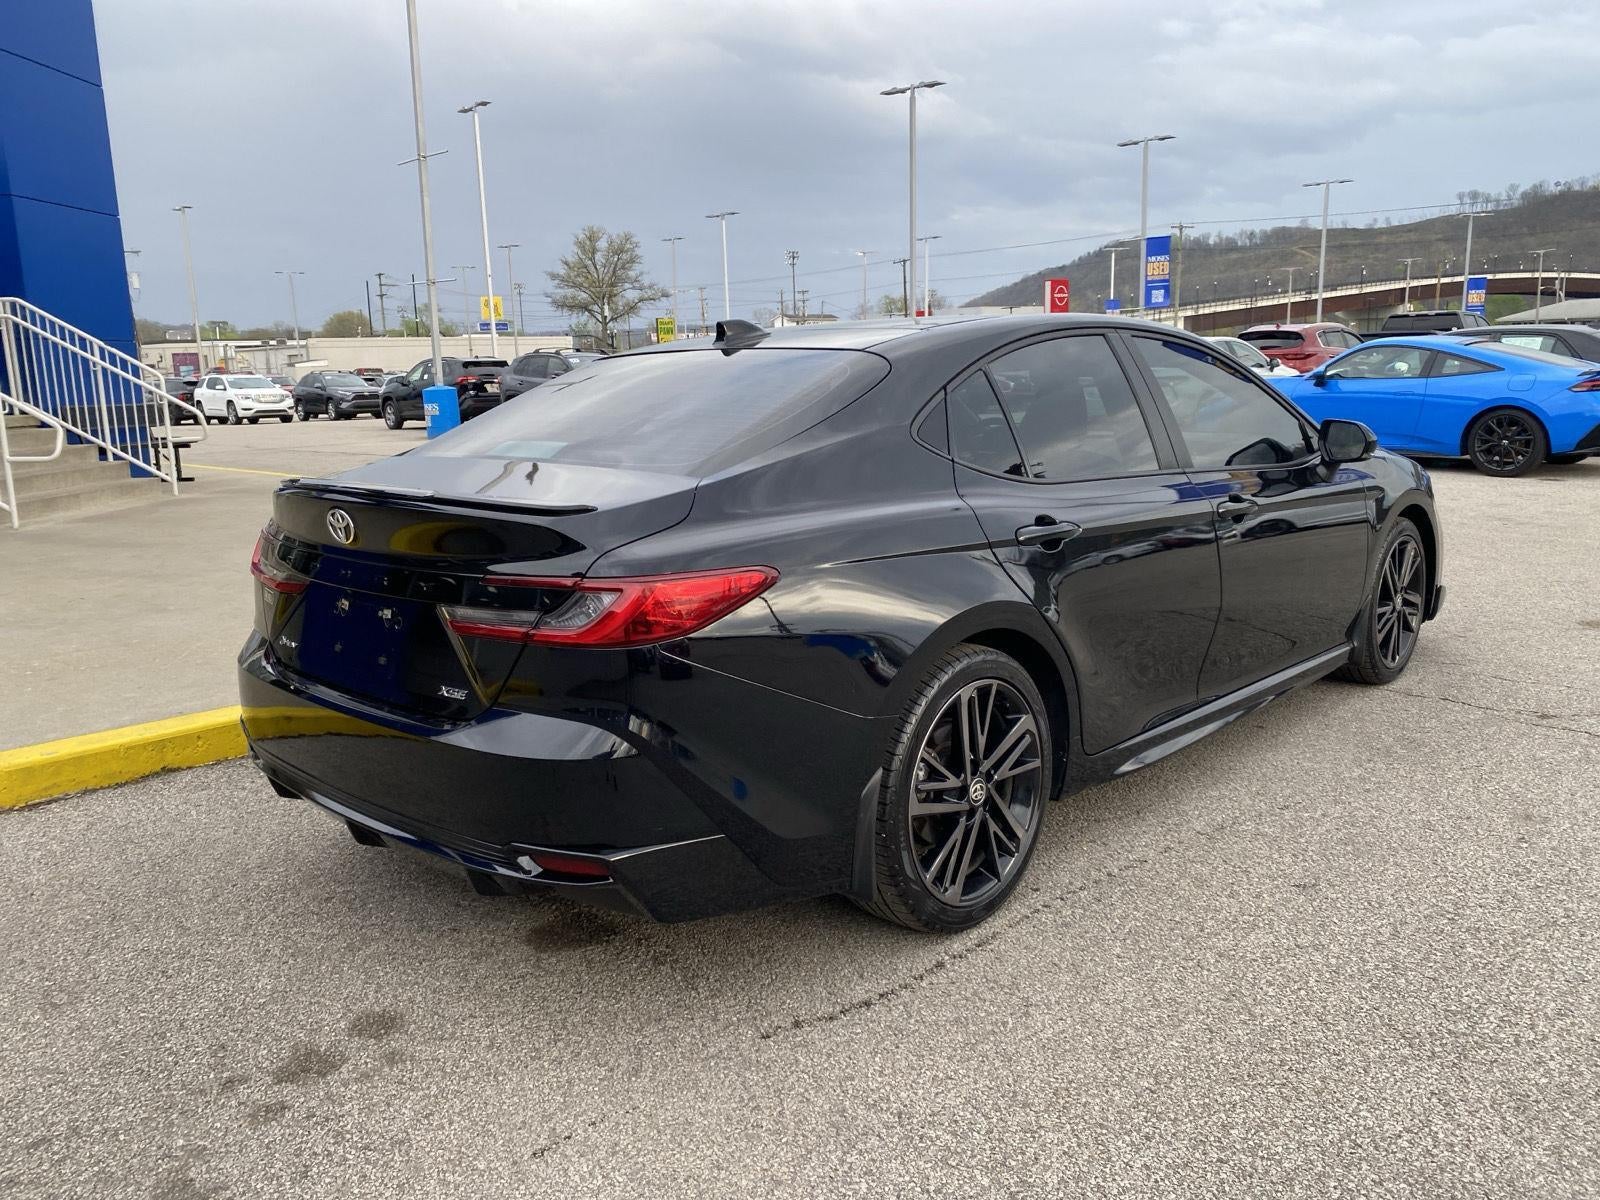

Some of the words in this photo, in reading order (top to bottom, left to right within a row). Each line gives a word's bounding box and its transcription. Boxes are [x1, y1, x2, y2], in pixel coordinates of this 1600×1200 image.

[1147, 262, 1170, 275] USED
[659, 327, 674, 335] PAWN
[437, 686, 469, 700] XSE
